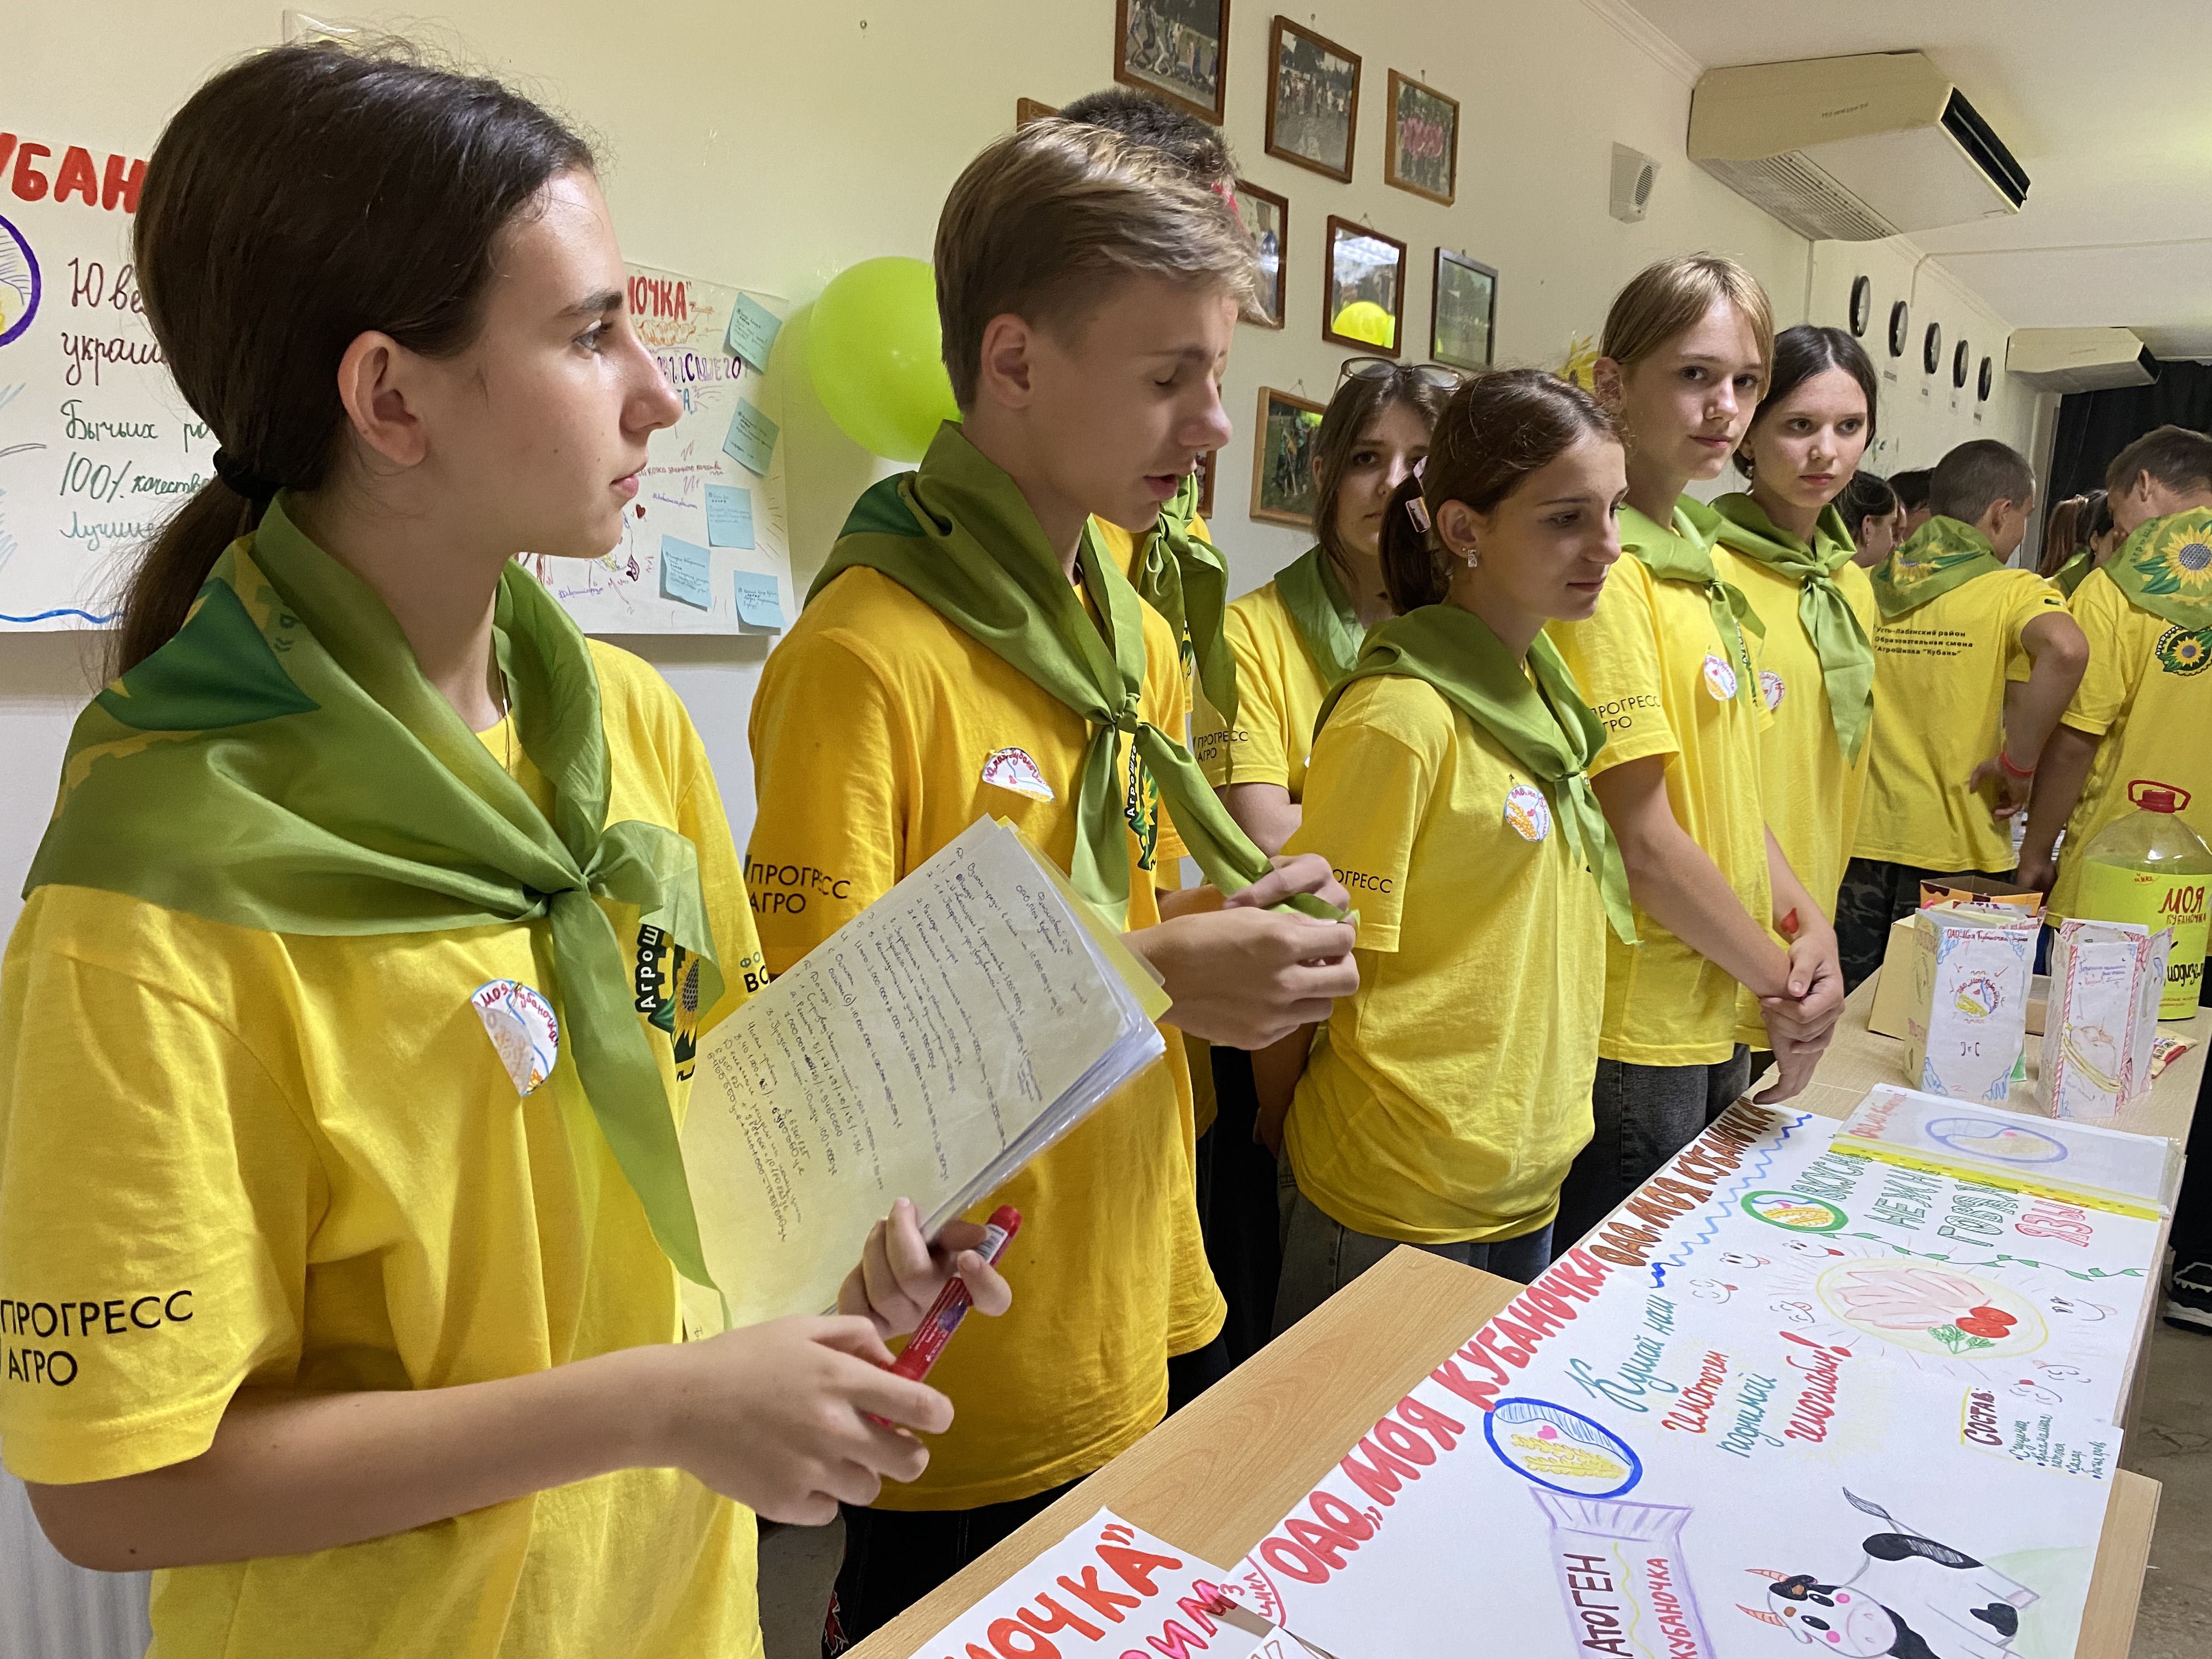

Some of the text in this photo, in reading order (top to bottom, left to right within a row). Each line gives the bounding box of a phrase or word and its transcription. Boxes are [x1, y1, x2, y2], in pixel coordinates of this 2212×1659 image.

[1197, 747, 1217, 763] АГРО
[750, 891, 806, 914] АГРО
[2158, 885, 2205, 914] МОЯ
[1589, 1221, 1662, 1267] ОАО
[0, 1290, 193, 1338] ПРОГРЕСС
[8, 1346, 78, 1386] АГРО
[1568, 1334, 1679, 1413] Кушай
[1260, 1491, 1374, 1584] ОАО
[1430, 1247, 1615, 1413] КУБАНОЧКА
[1716, 1373, 1785, 1458] поднимай
